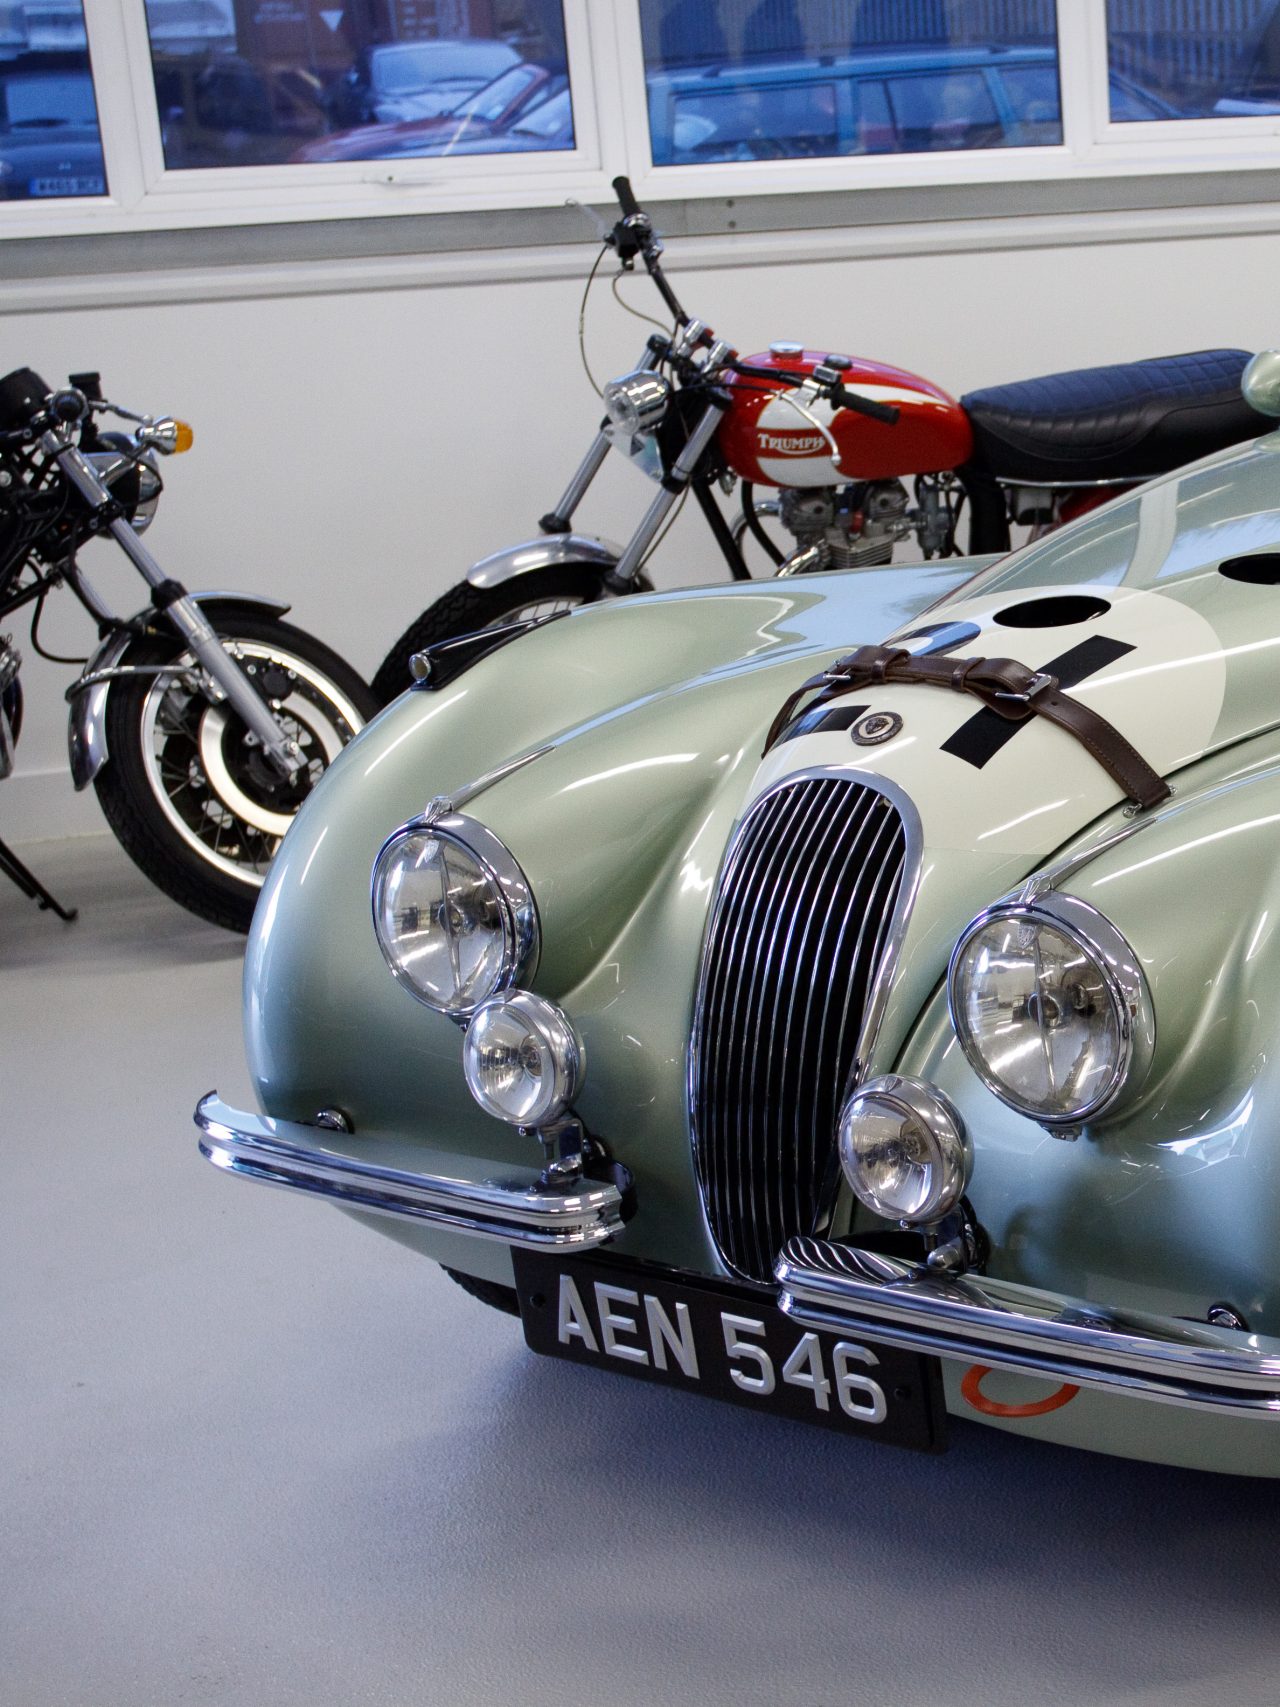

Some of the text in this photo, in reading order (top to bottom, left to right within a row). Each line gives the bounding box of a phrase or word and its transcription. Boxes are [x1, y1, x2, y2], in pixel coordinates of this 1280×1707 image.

[757, 433, 826, 455] TRIUMPH
[557, 1273, 888, 1425] AEN 546
